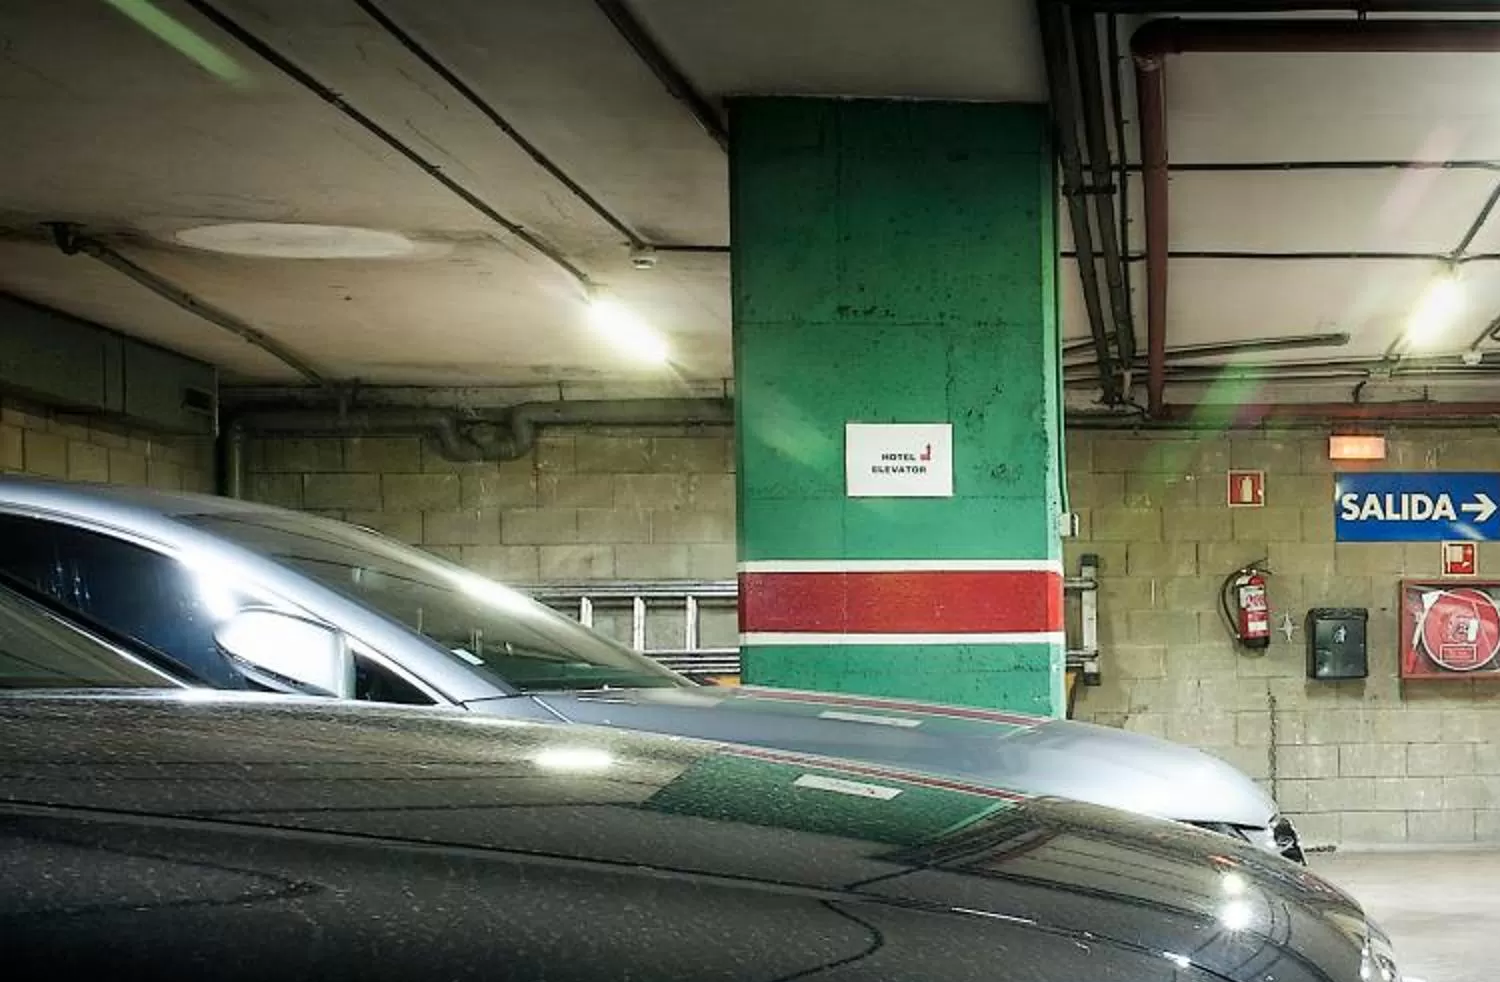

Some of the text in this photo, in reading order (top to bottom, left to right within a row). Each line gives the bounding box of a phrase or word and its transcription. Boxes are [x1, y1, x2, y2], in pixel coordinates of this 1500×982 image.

[881, 453, 916, 461] HOTEL
[871, 465, 927, 473] ELEVATOR
[1341, 493, 1457, 521] SALIDA
